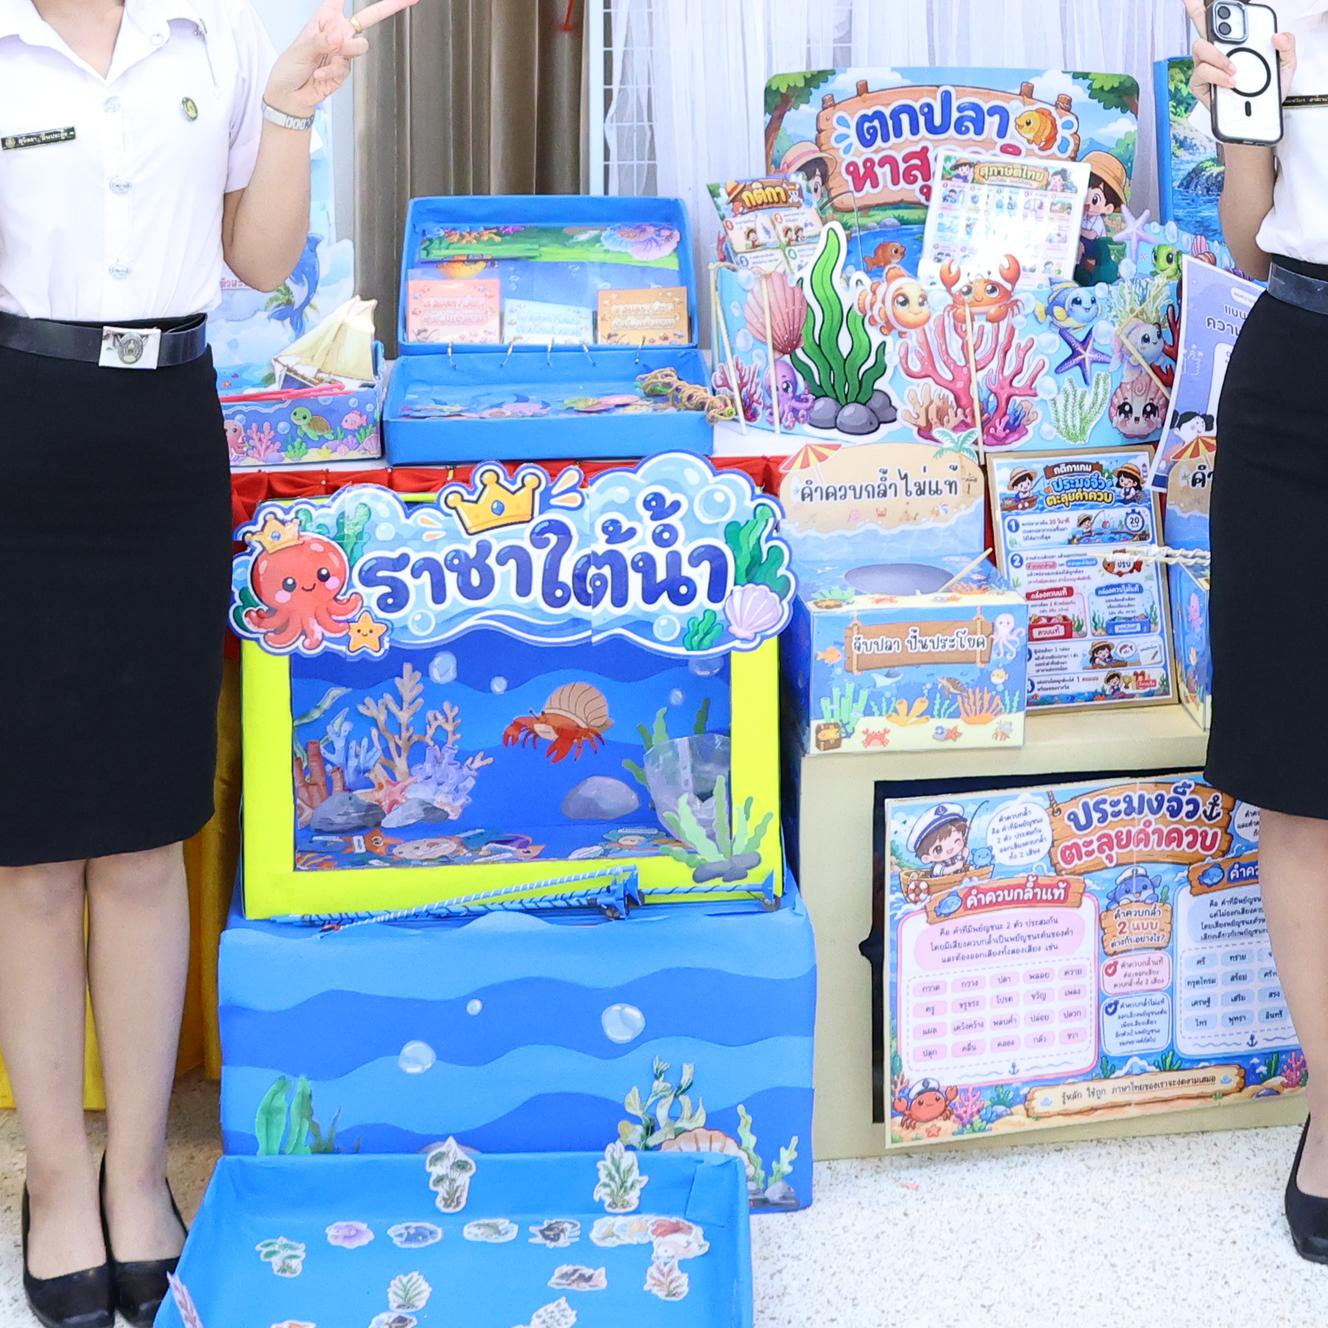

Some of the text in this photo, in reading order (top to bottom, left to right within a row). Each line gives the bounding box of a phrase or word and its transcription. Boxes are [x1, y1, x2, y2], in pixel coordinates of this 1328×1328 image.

[855, 88, 1011, 150] ตกปลา
[978, 165, 1045, 182] สุภาษิตไทย
[742, 181, 788, 208] กติกา
[1053, 462, 1092, 475] กติกาเกม
[800, 465, 959, 502] คำควบกล้ำไม่แท้
[1052, 474, 1108, 491] ประมงจิ๋ว
[1046, 488, 1113, 507] ตะลุยคำควบ
[1129, 516, 1140, 525] 20
[356, 493, 729, 611] ราชาใต้น้ำ
[852, 628, 987, 654] จับปลา ปั้นประโยค
[1066, 781, 1201, 832] ประมงจิ๋ว
[1059, 820, 1220, 865] ตะลุยคำควบ
[966, 873, 1067, 909] คำควบกล้ำแท้
[1115, 904, 1162, 920] คำควบกล้ำ
[953, 923, 1003, 936] คำที่มีพยัญชนะ
[1117, 921, 1158, 935] 2 แบบ
